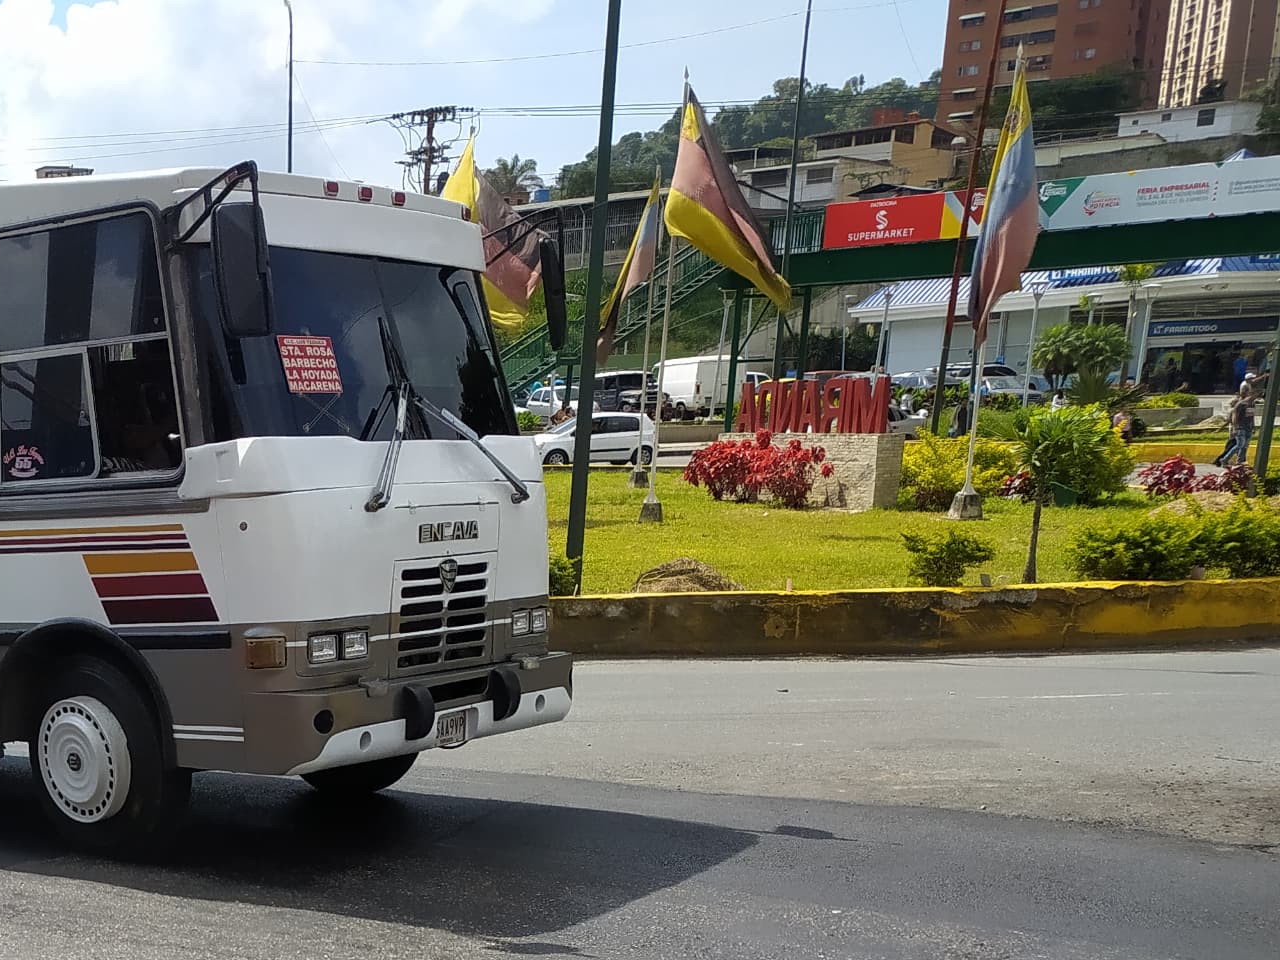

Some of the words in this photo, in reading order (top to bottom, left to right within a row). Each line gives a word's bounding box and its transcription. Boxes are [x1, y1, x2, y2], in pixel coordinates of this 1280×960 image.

[1137, 187, 1158, 195] FERIA
[1159, 181, 1210, 192] EMPRESARIAL
[848, 228, 914, 241] SUPERMARKET
[1164, 324, 1218, 334] FARMATODO
[281, 346, 305, 356] STA.
[306, 346, 334, 357] ROSA
[283, 358, 336, 368] BARBECHO
[286, 369, 300, 380] LA
[301, 369, 339, 380] HOYADA
[289, 380, 342, 391] MACARENA
[418, 520, 479, 544] ENCAVA
